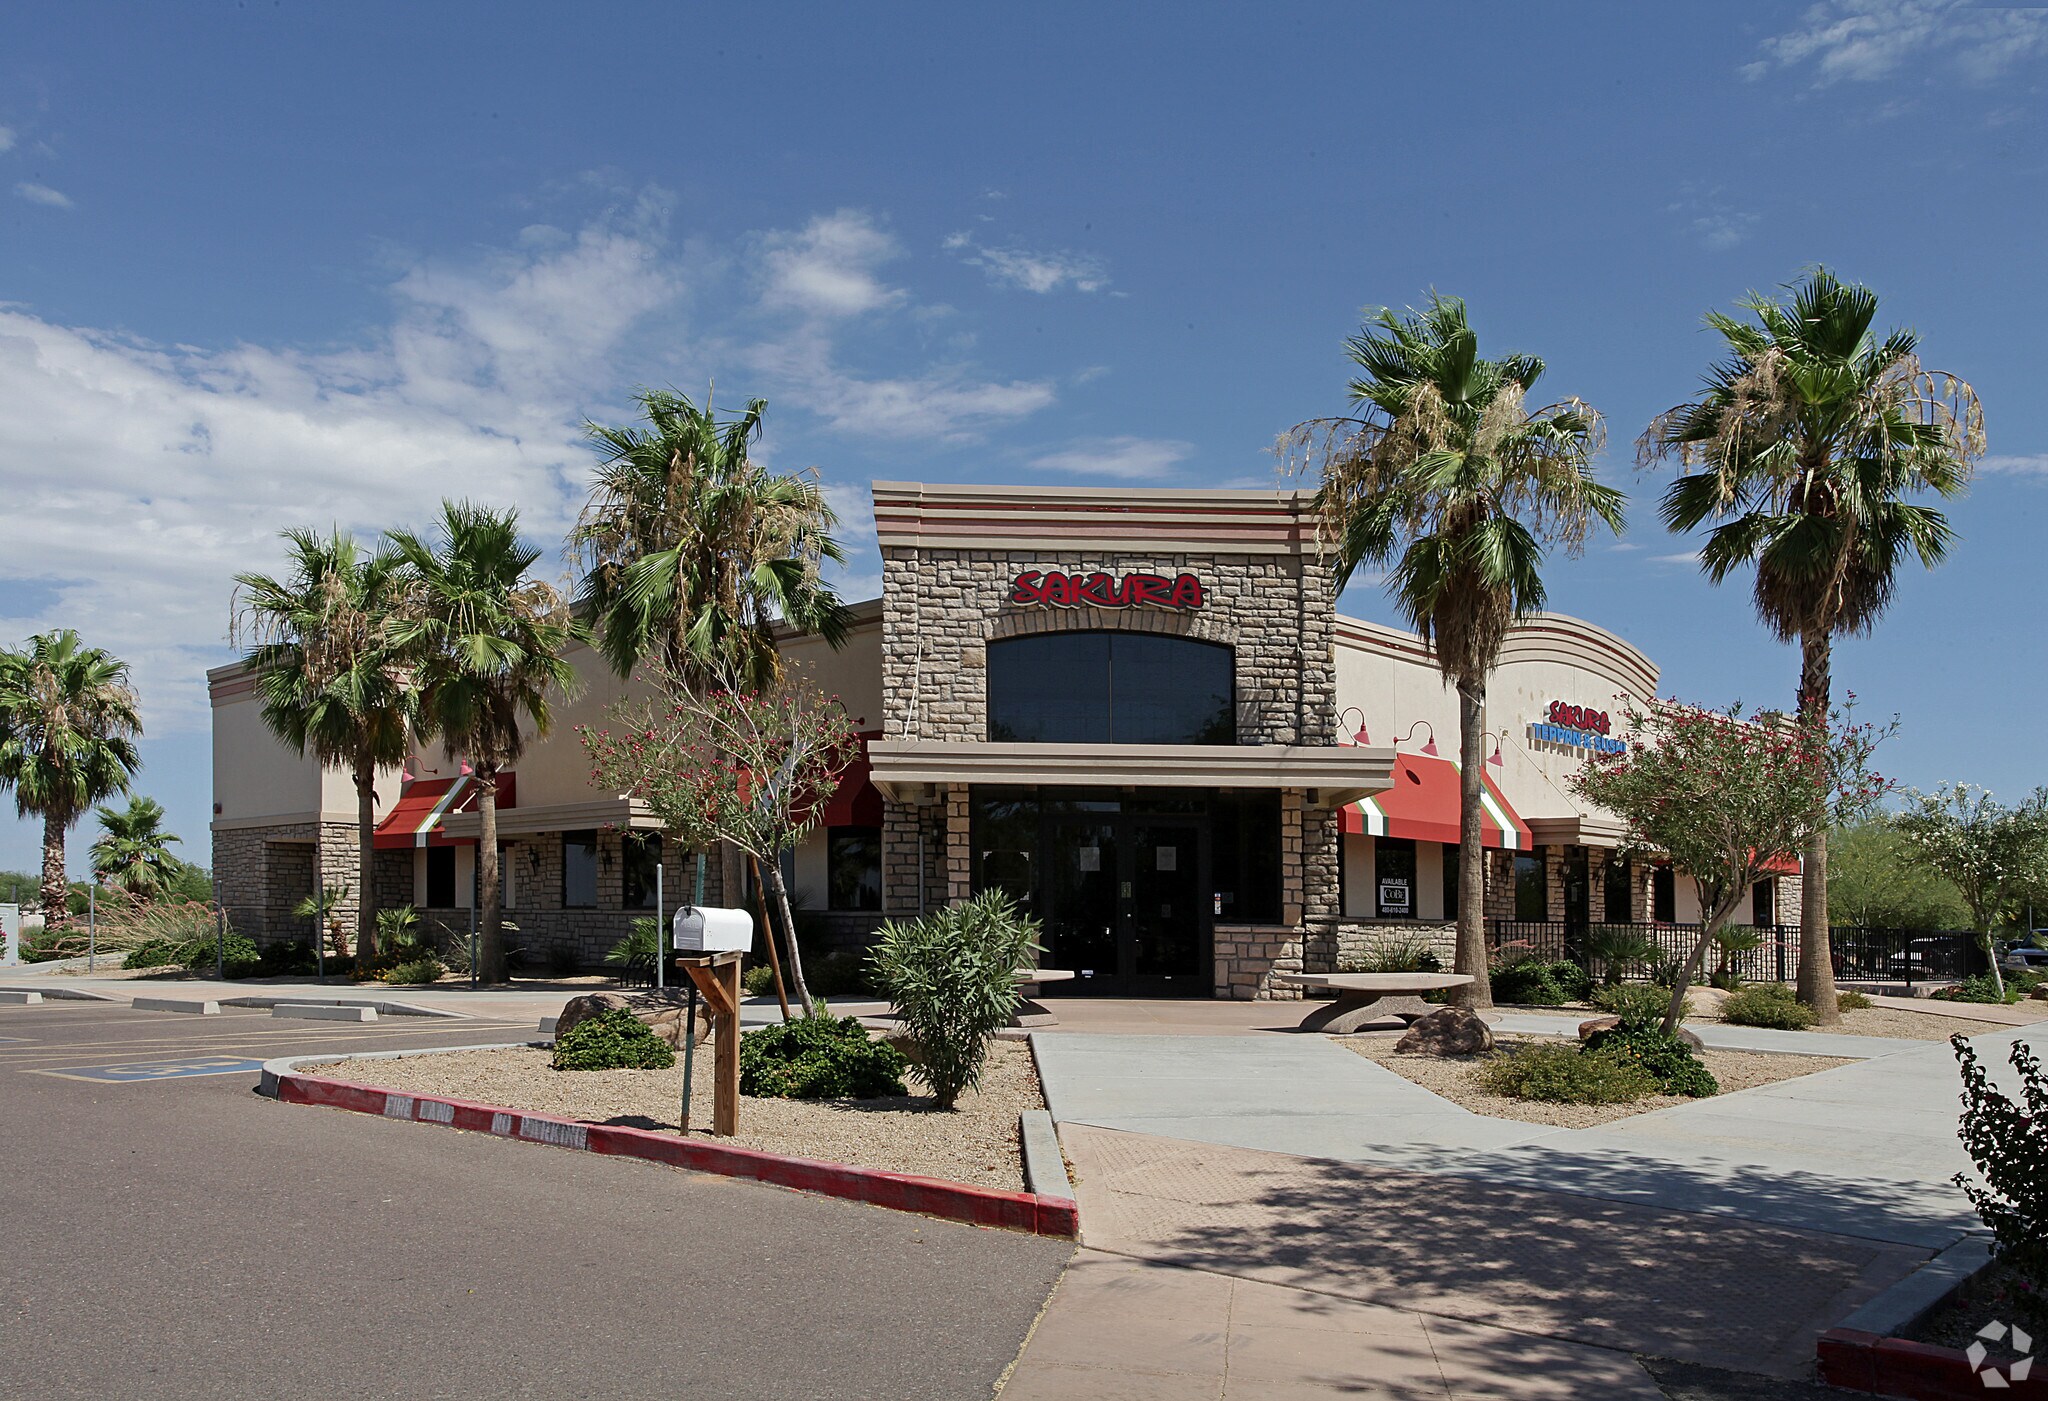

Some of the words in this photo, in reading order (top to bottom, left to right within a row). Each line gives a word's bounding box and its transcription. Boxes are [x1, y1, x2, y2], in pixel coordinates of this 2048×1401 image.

[1011, 570, 1209, 610] SAKURA
[1549, 700, 1611, 735] SAKURA
[1532, 723, 1582, 747] TEPPAN
[1583, 733, 1592, 749] &
[1594, 736, 1626, 754] SUSHI
[385, 1095, 414, 1118] FIRE
[492, 1113, 512, 1134] NO
[520, 1117, 587, 1150] PARKING
